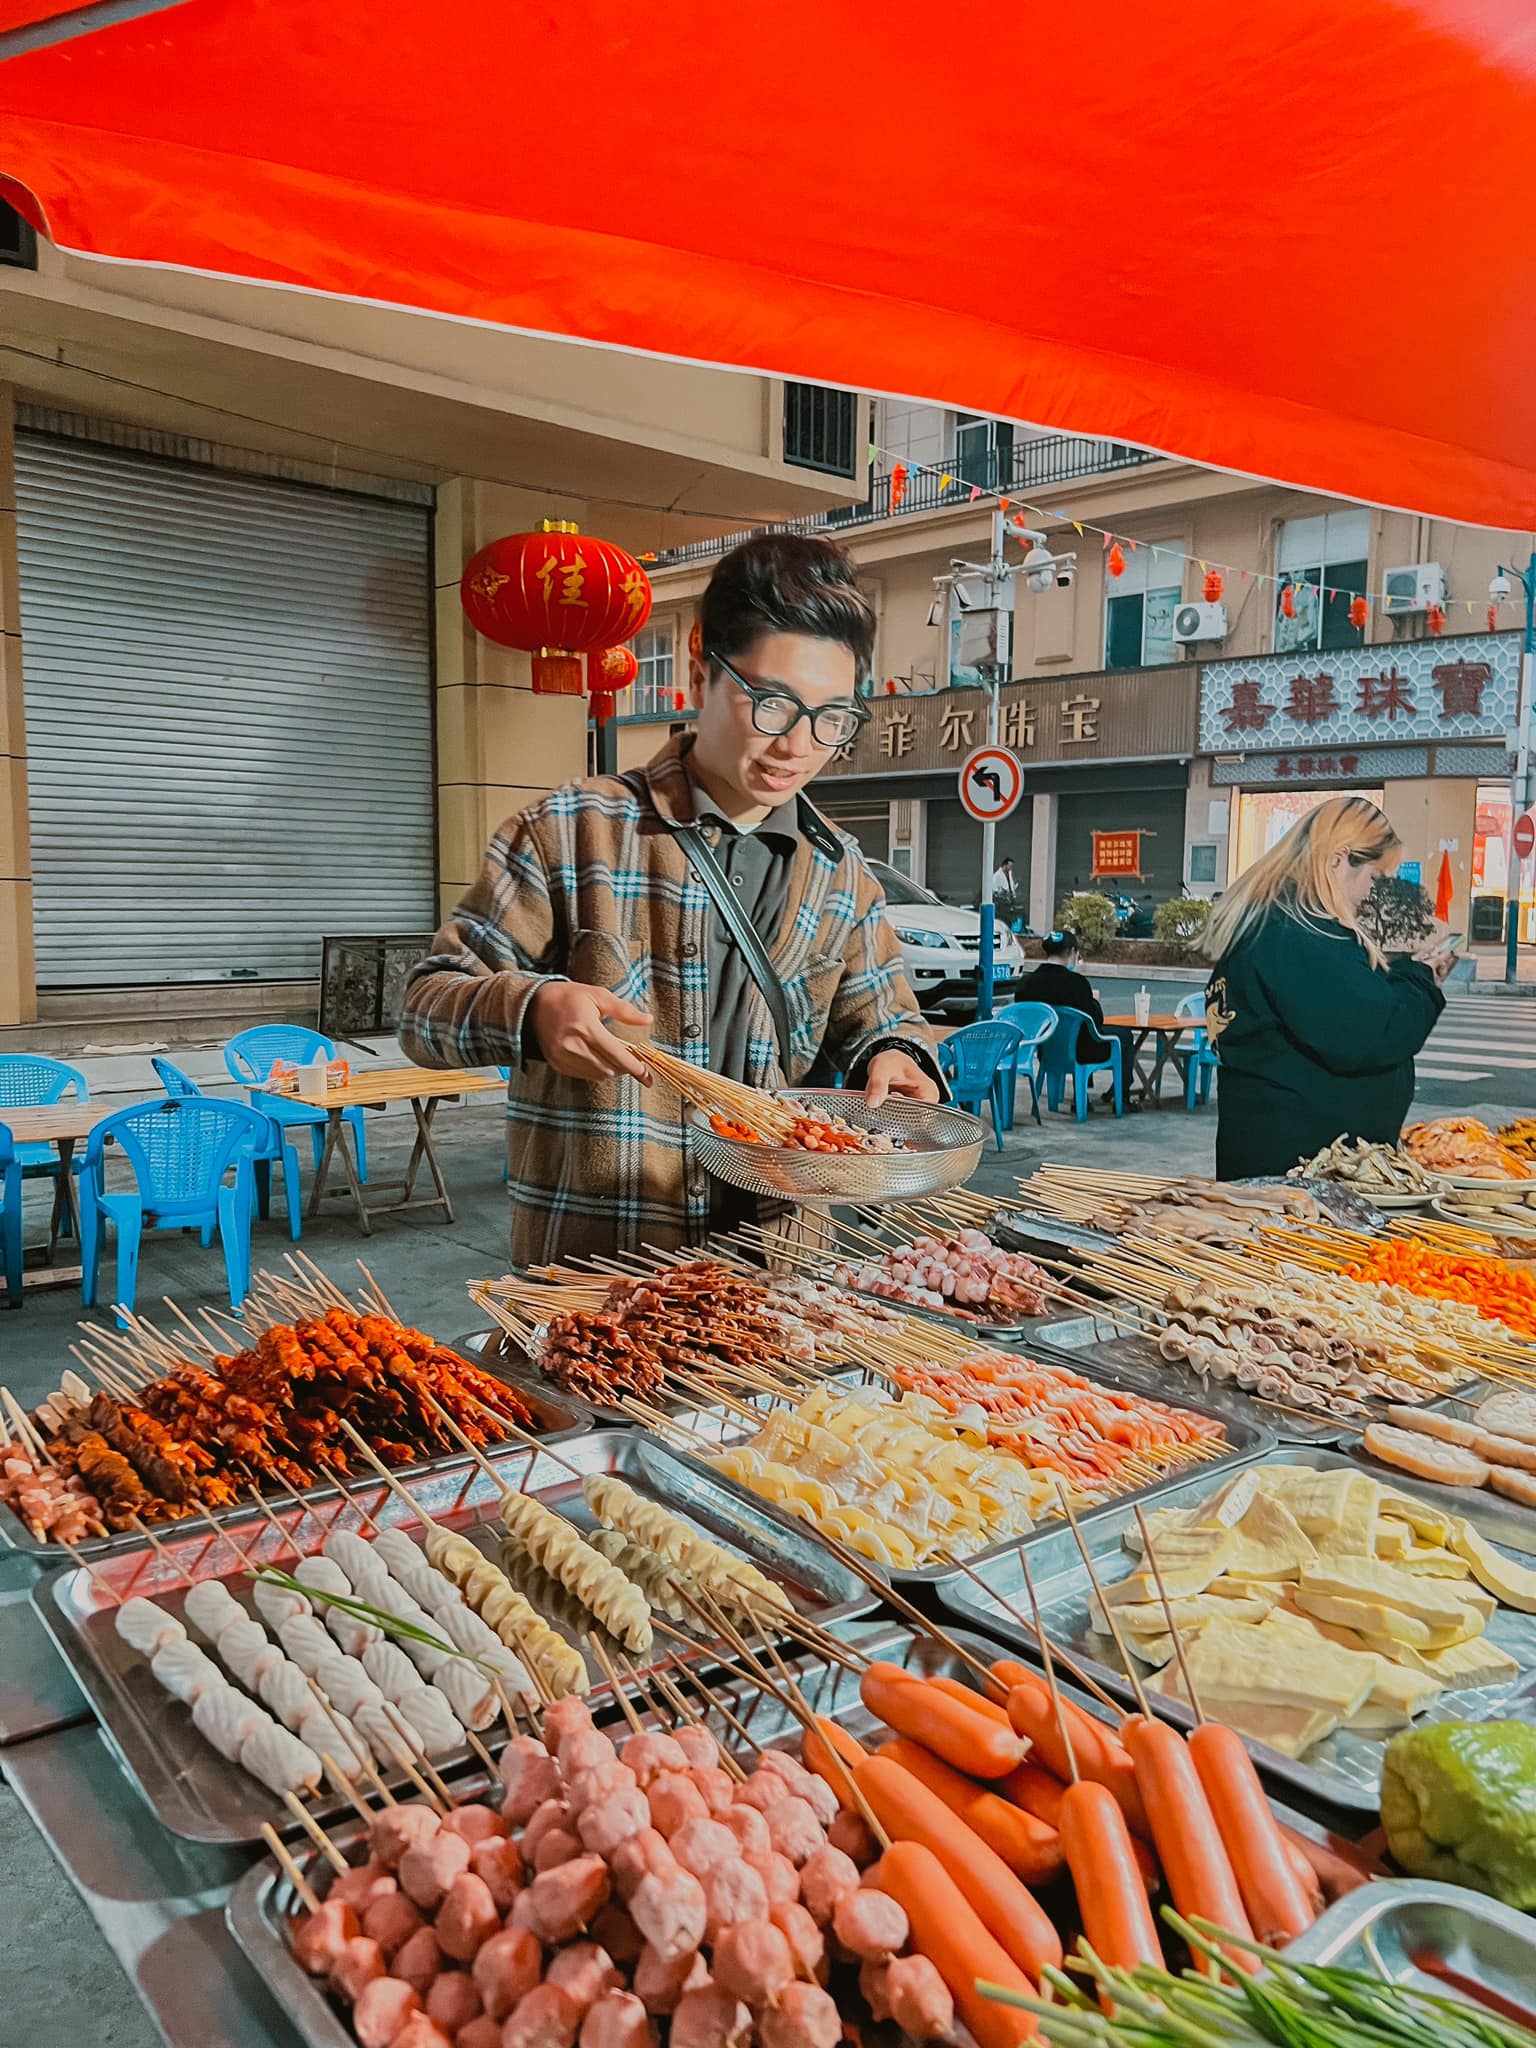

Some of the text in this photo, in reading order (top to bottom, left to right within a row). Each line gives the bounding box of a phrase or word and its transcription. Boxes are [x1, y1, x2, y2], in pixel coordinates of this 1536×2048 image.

[831, 694, 1101, 762] 菲尔珠宝
[1218, 658, 1491, 733] 嘉華珠寶
